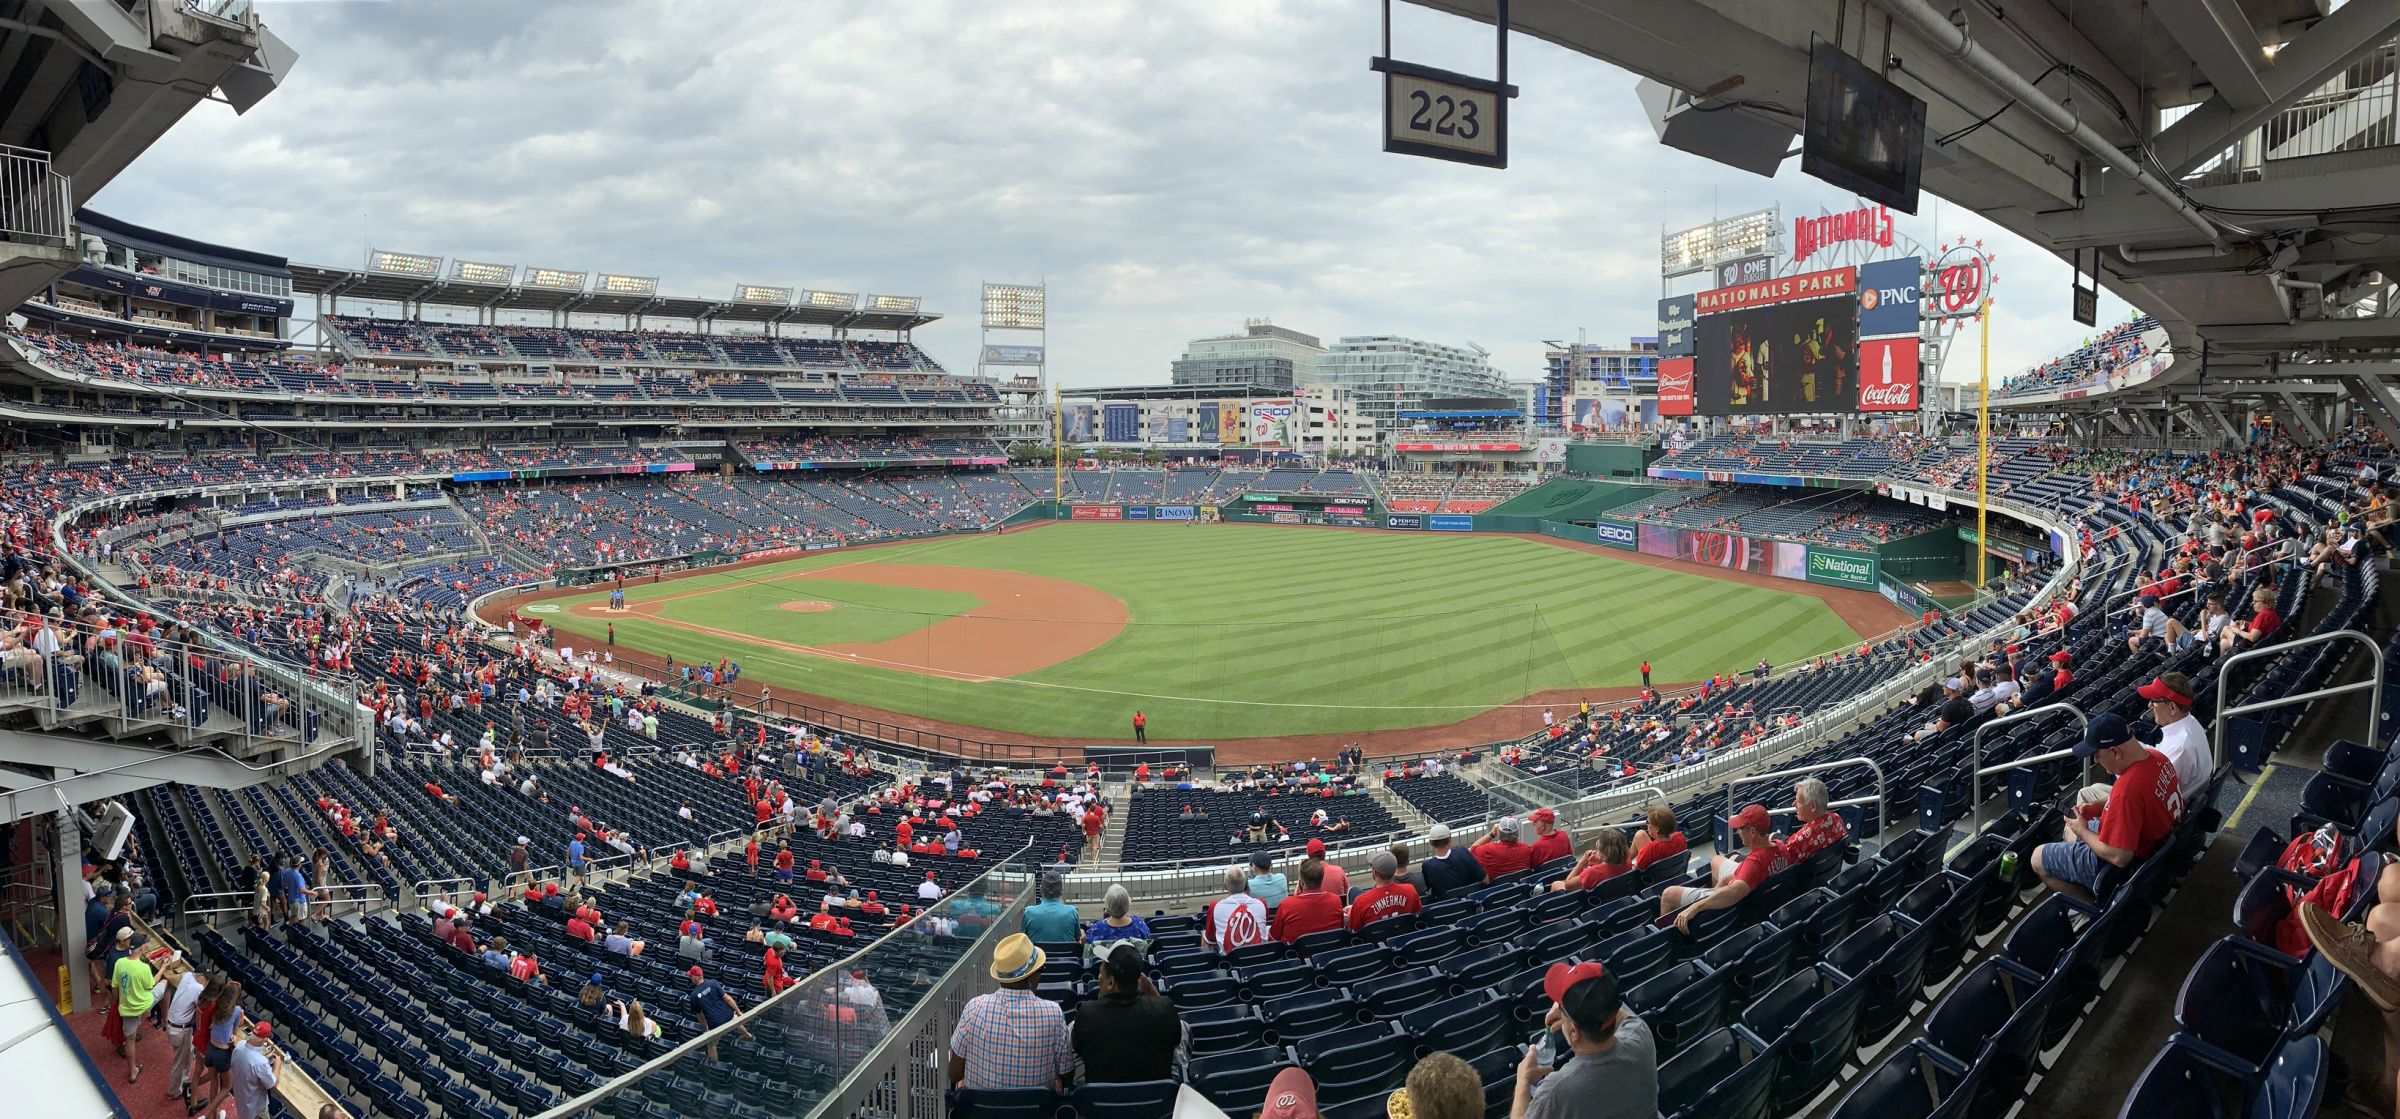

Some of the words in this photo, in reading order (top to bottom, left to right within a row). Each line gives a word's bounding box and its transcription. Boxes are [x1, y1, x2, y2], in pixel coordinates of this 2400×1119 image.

[1409, 89, 1480, 140] 223
[1794, 203, 1894, 262] NATIONALS
[1743, 259, 1767, 273] ONE
[1743, 271, 1766, 284] PURSUIT
[1940, 257, 1983, 311] W
[1701, 282, 1791, 308] NATIONALS
[1799, 273, 1845, 293] PARK
[1881, 286, 1916, 306] PNC
[1861, 382, 1914, 406] Coca-Cola
[1253, 407, 1291, 417] GEICO
[1165, 509, 1193, 517] INOVA
[1599, 525, 1634, 542] GEICO
[1825, 557, 1870, 575] National
[1899, 589, 1917, 606] DELTA
[1370, 895, 1407, 914] ZIMMERMAN
[1230, 910, 1258, 947] W
